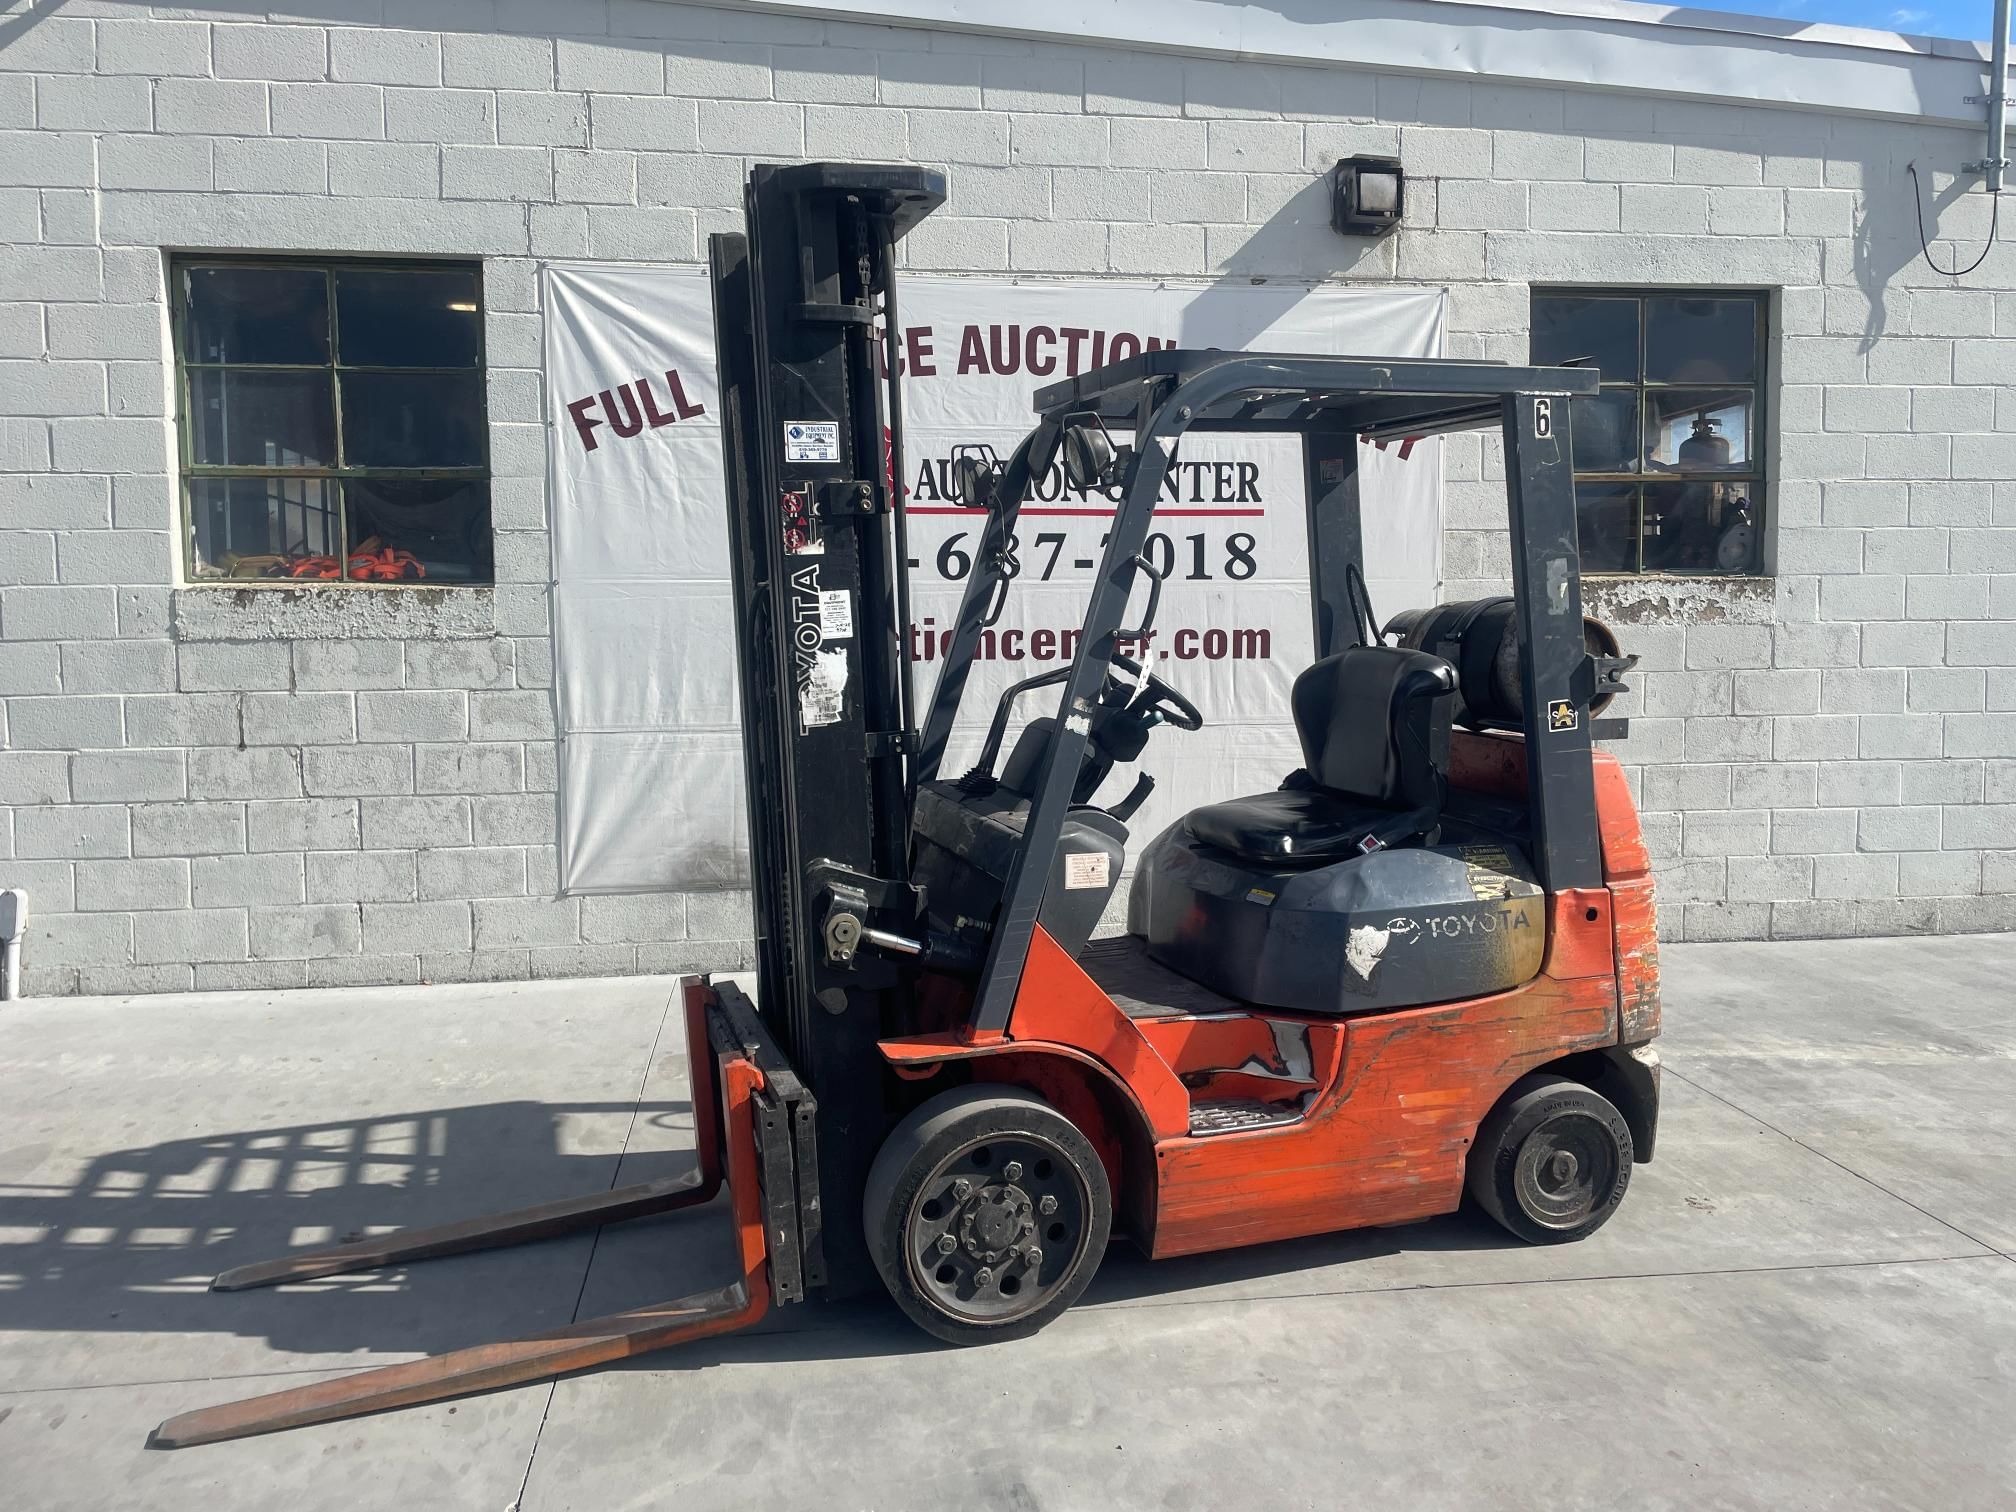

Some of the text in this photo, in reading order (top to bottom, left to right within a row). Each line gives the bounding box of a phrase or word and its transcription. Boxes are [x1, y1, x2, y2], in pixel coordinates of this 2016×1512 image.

[567, 369, 705, 452] FULL
[957, 325, 1177, 377] AUCTIO
[1536, 400, 1550, 436] 6
[1104, 461, 1262, 503] NTER
[1425, 909, 1531, 938] TOYOTA
